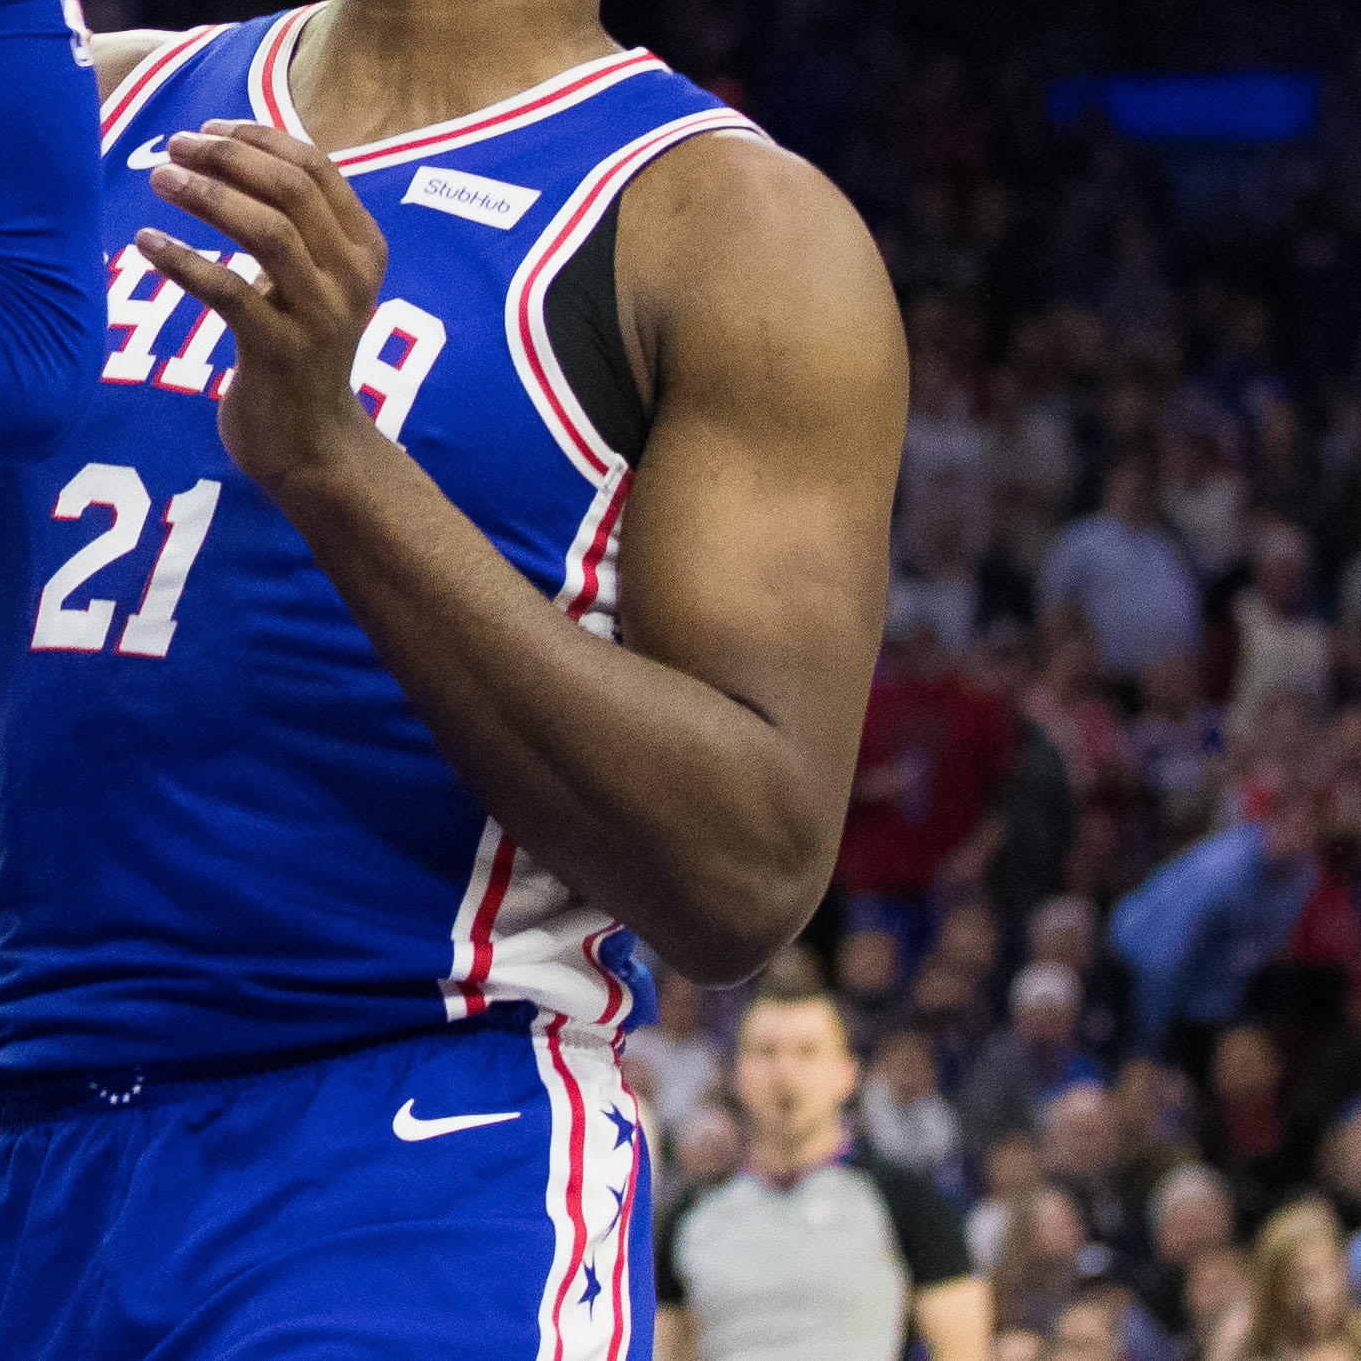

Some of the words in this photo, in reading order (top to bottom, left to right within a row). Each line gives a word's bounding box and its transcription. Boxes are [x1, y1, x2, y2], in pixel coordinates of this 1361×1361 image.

[423, 177, 511, 214] StubHub
[100, 243, 448, 452] HIA
[31, 462, 222, 659] 21
